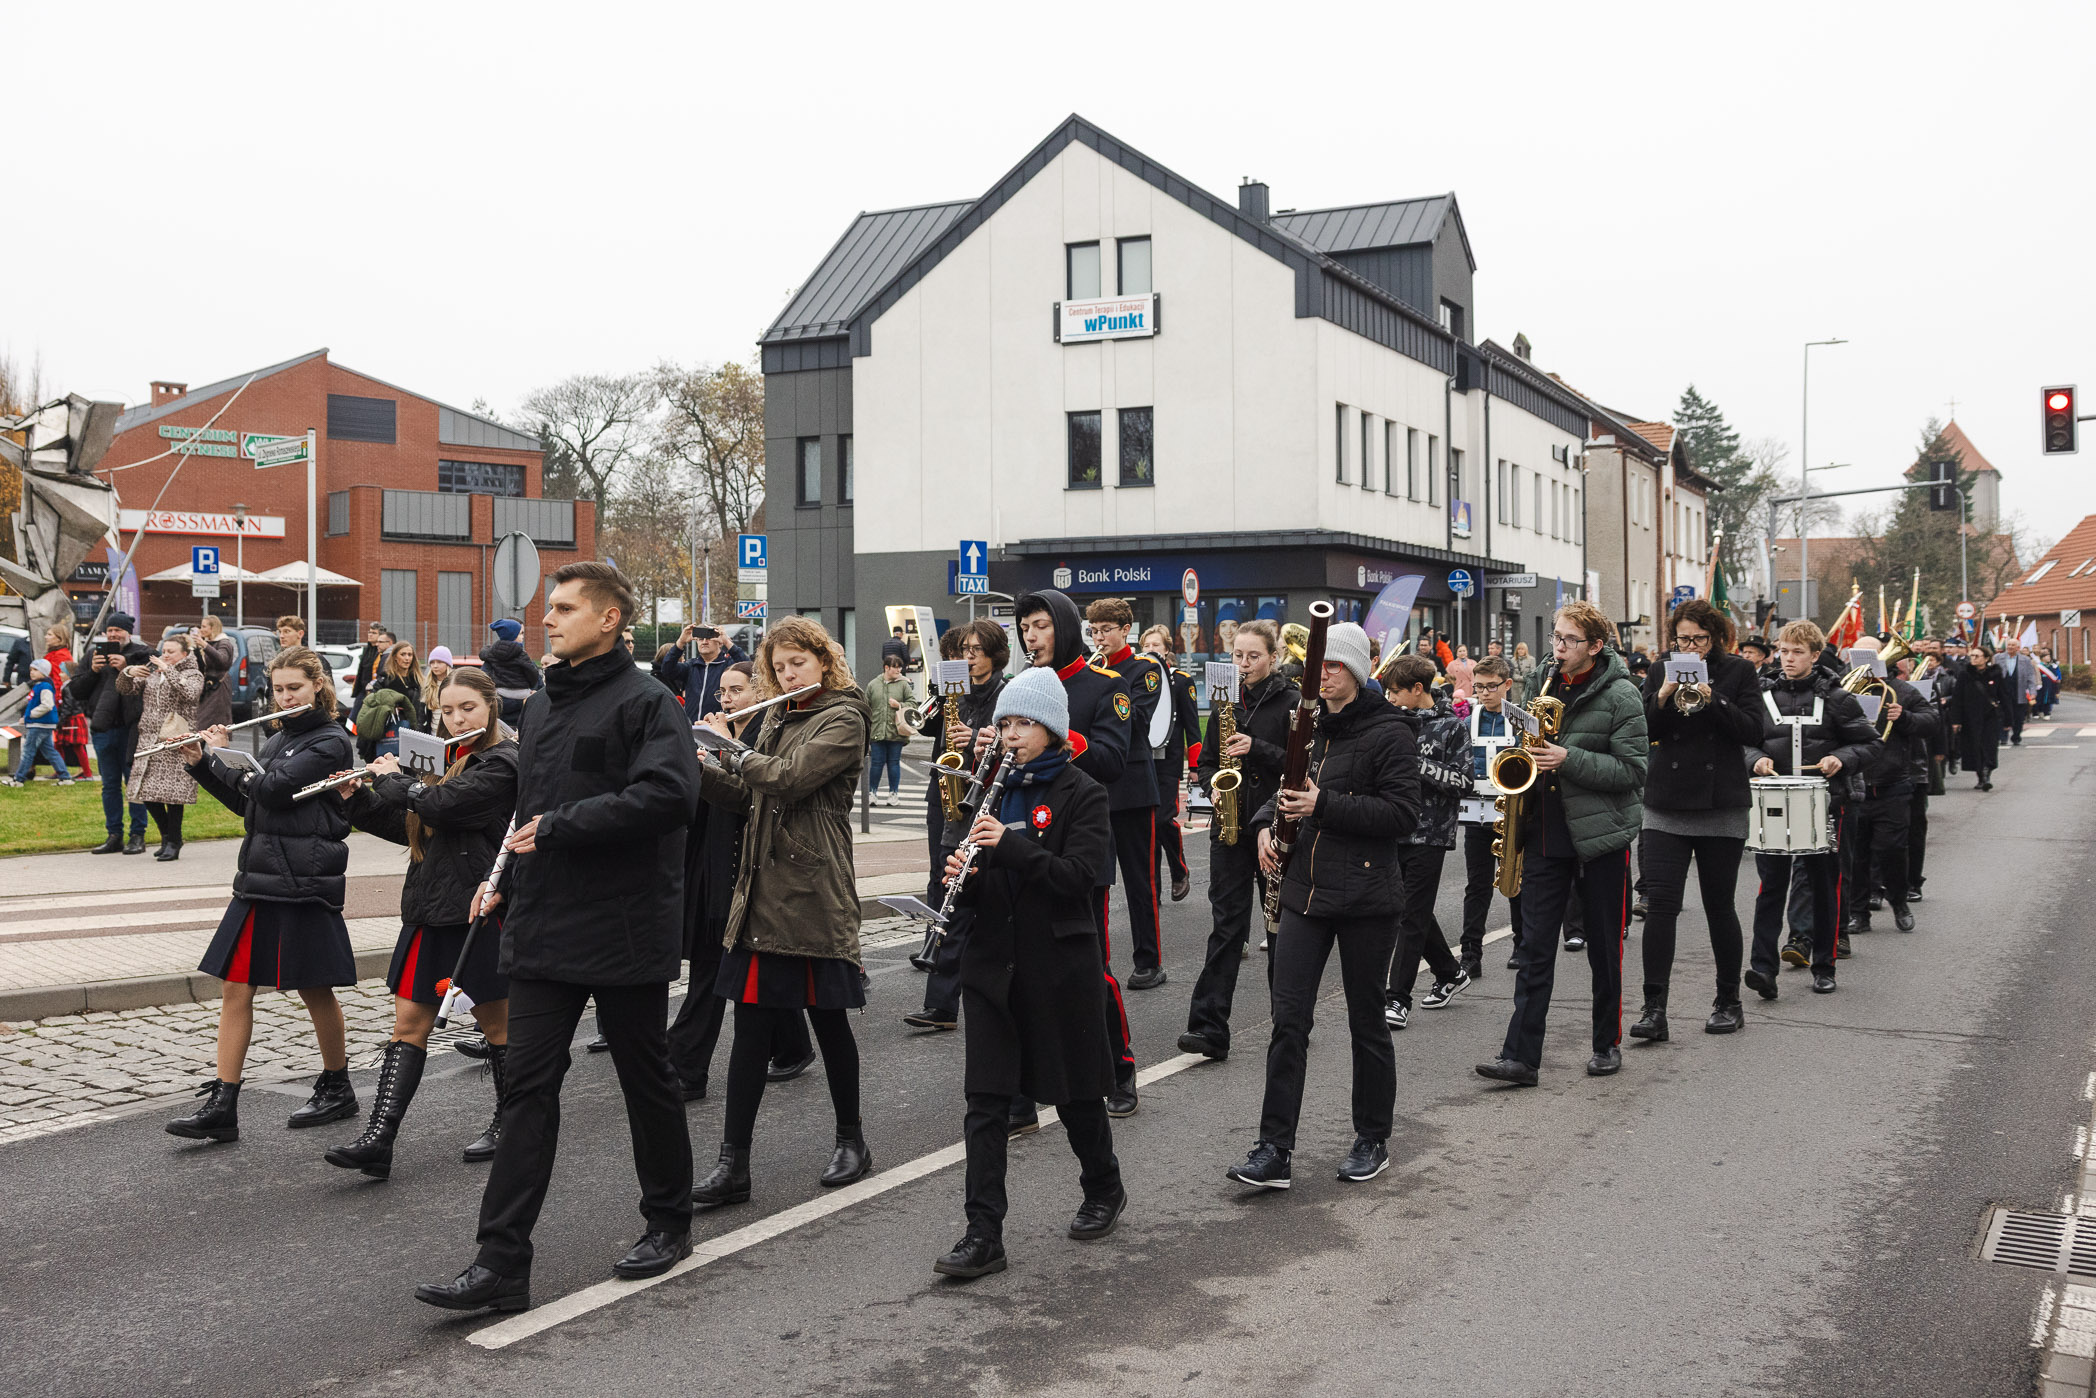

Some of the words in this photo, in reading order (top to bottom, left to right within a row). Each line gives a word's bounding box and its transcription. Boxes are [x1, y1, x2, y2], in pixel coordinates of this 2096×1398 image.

[1068, 308, 1093, 317] Centrum
[1095, 304, 1114, 315] Terapii
[1119, 302, 1144, 313] Edukacji
[1085, 313, 1144, 332] wPunkt
[159, 425, 238, 443] CENTRUM
[170, 441, 238, 458] FITNESS
[146, 511, 261, 532] ROSSMANN
[1078, 568, 1110, 583] Bank
[1114, 567, 1151, 582] Polski
[1367, 569, 1378, 583] Bank
[1486, 576, 1533, 585] NOTARIUSZ
[960, 578, 987, 592] TAXI
[739, 602, 767, 617] TAXI
